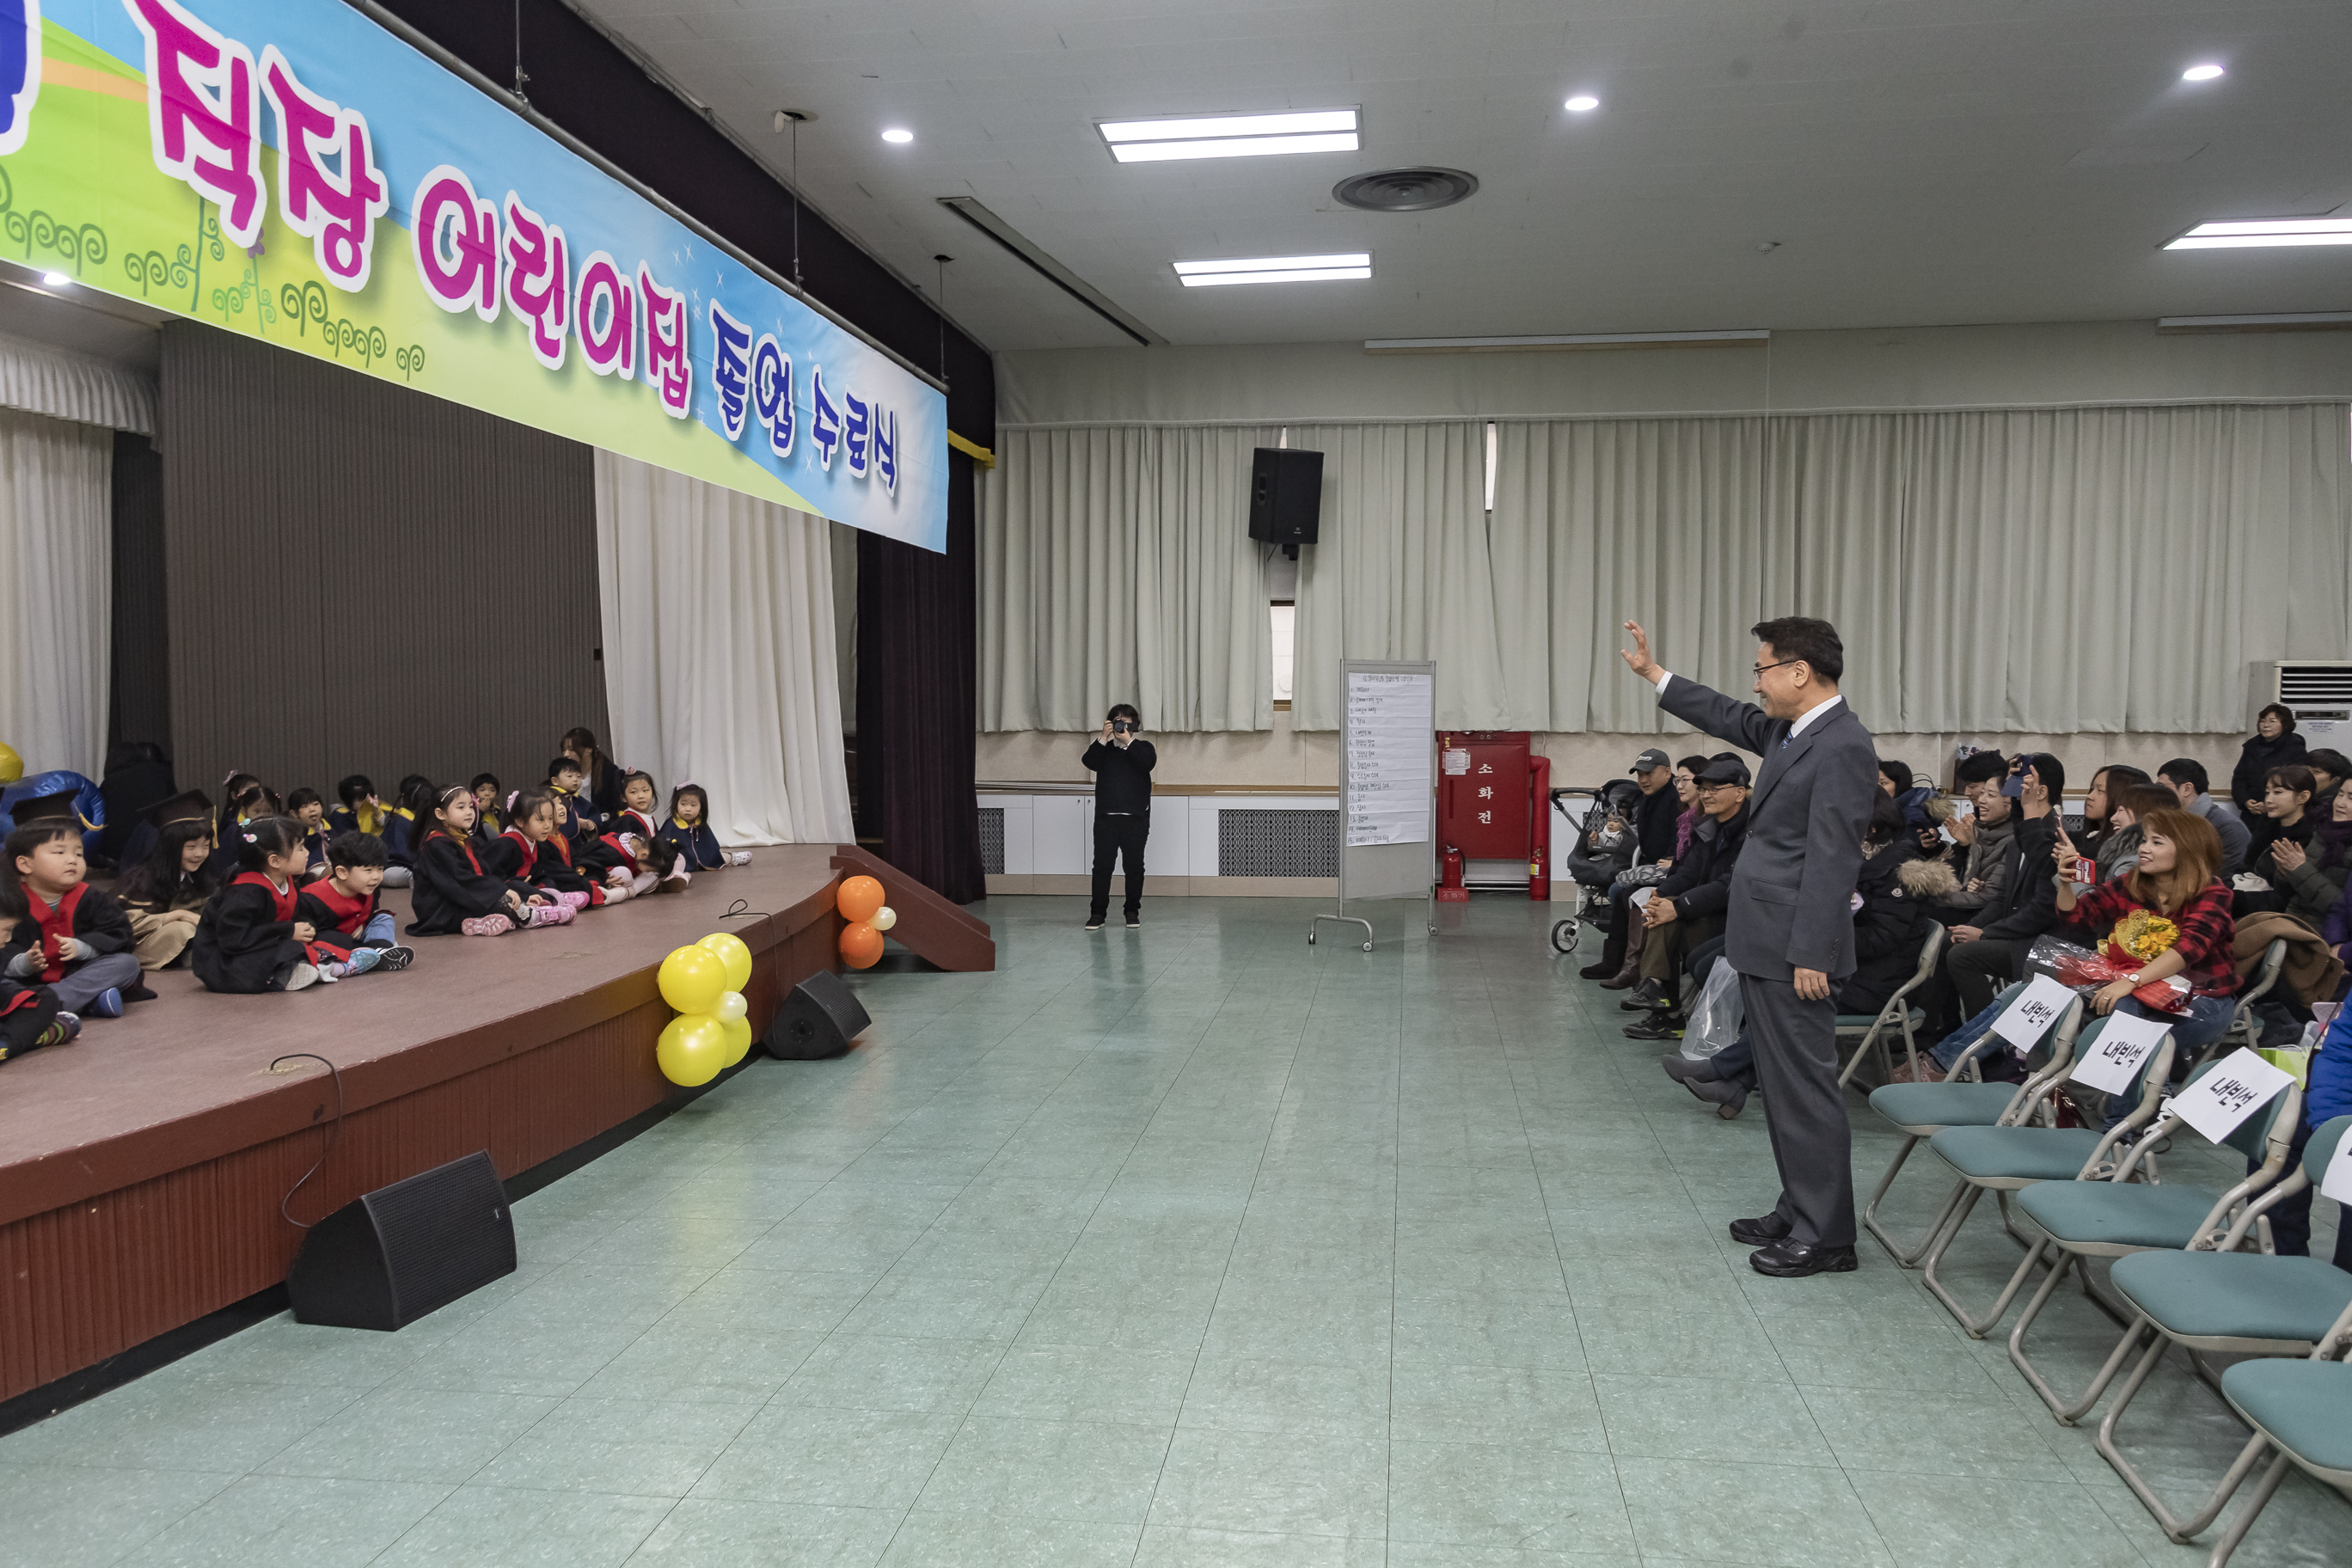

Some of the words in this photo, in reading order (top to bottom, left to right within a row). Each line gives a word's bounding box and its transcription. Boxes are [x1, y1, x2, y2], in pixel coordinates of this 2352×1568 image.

[129, 0, 383, 282] 직장
[415, 174, 689, 413] 어린이집
[712, 306, 793, 451] 졸업
[812, 368, 897, 492] 수료식
[1478, 763, 1494, 824] 소화전
[2020, 1000, 2055, 1028] 내빈석
[2102, 1041, 2146, 1069] 내빈석
[2209, 1077, 2258, 1112] 내빈석
